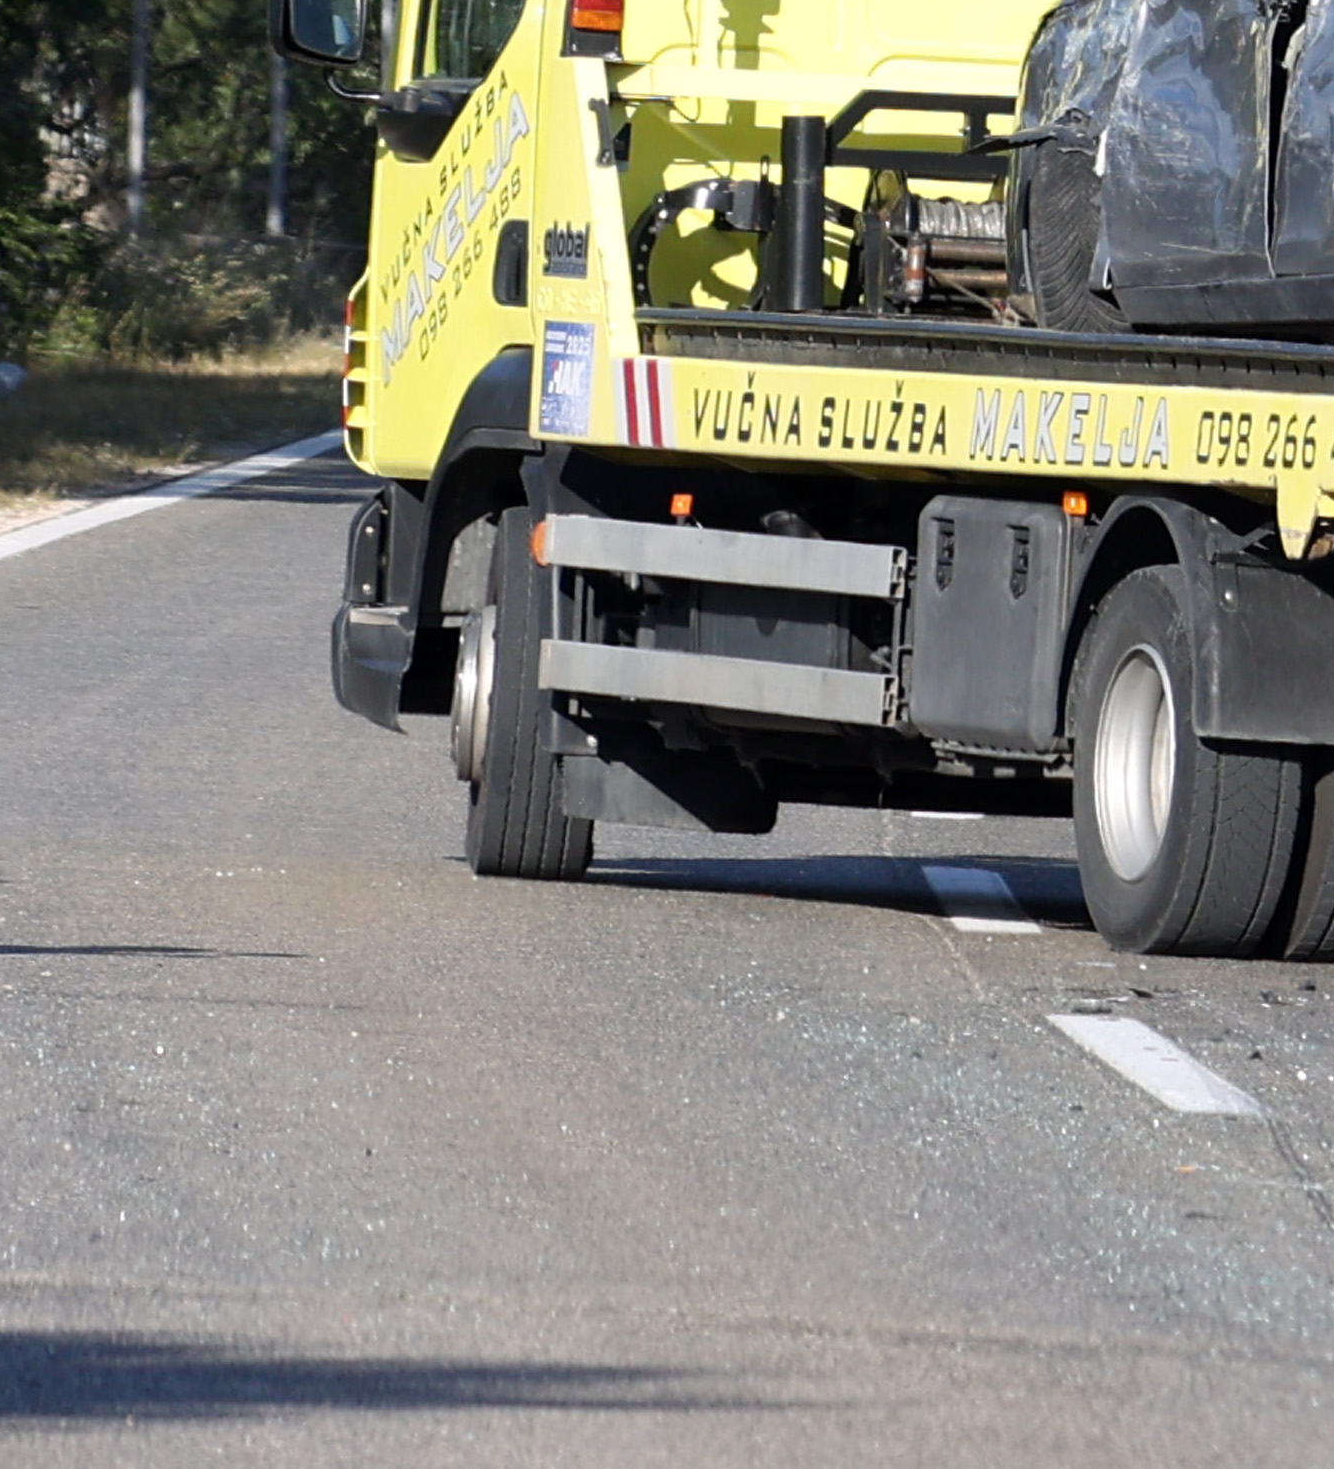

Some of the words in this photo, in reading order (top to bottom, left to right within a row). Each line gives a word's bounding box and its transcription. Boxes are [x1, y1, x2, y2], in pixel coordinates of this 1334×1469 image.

[379, 196, 434, 304] VUČNA
[439, 69, 509, 197] SLUŽBA
[380, 90, 530, 389] MAKELJA
[419, 290, 449, 362] 098
[453, 228, 483, 298] 266
[488, 165, 522, 231] 488
[543, 218, 591, 272] global
[692, 371, 802, 446] VUČNA
[817, 380, 948, 456] SLUŽBA
[969, 387, 1168, 469] MAKELJA
[1195, 410, 1253, 467] 098
[1264, 413, 1318, 470] 266
